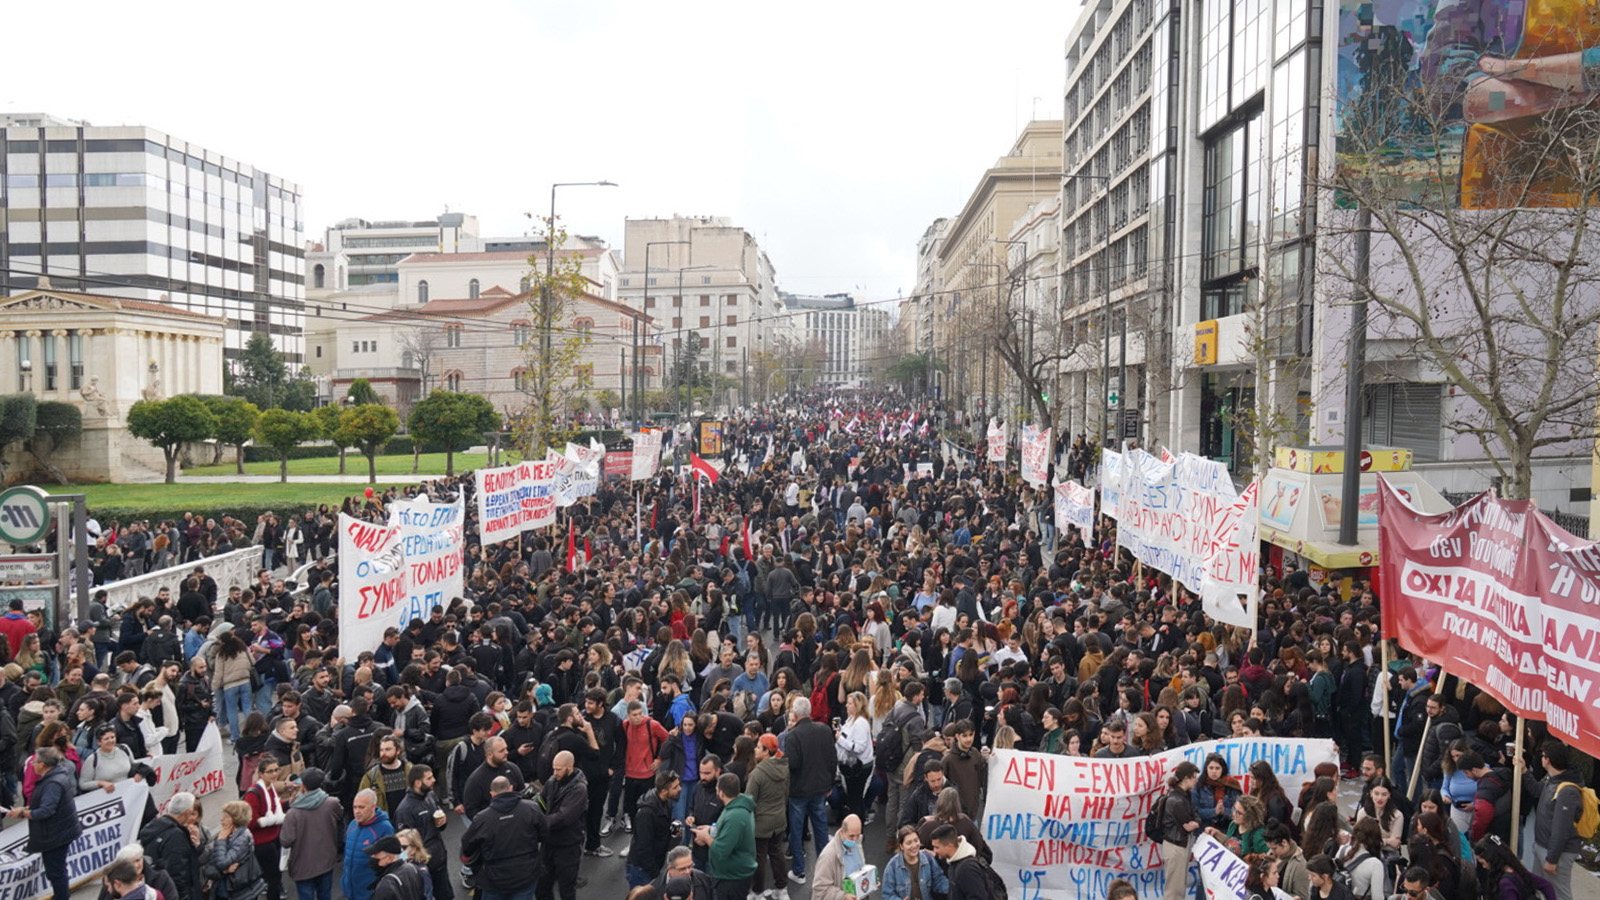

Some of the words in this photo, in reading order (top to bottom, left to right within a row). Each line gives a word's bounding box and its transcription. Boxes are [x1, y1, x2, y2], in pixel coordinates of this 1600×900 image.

[1406, 569, 1452, 598] ΟΧΙ
[1003, 757, 1055, 792] ΔΕΝ
[1074, 758, 1168, 795] ΞΕΧΝΑΜΕ
[1044, 794, 1072, 821] ΝΑ
[1081, 796, 1115, 820] ΜΗ
[95, 823, 122, 845] ΜΑΣ
[987, 813, 1102, 849] ΠΑΛΕΥΟΥΜΕ
[1104, 821, 1131, 846] ΓΙΑ
[1130, 845, 1143, 870] &
[1200, 840, 1226, 873] ΤΑ
